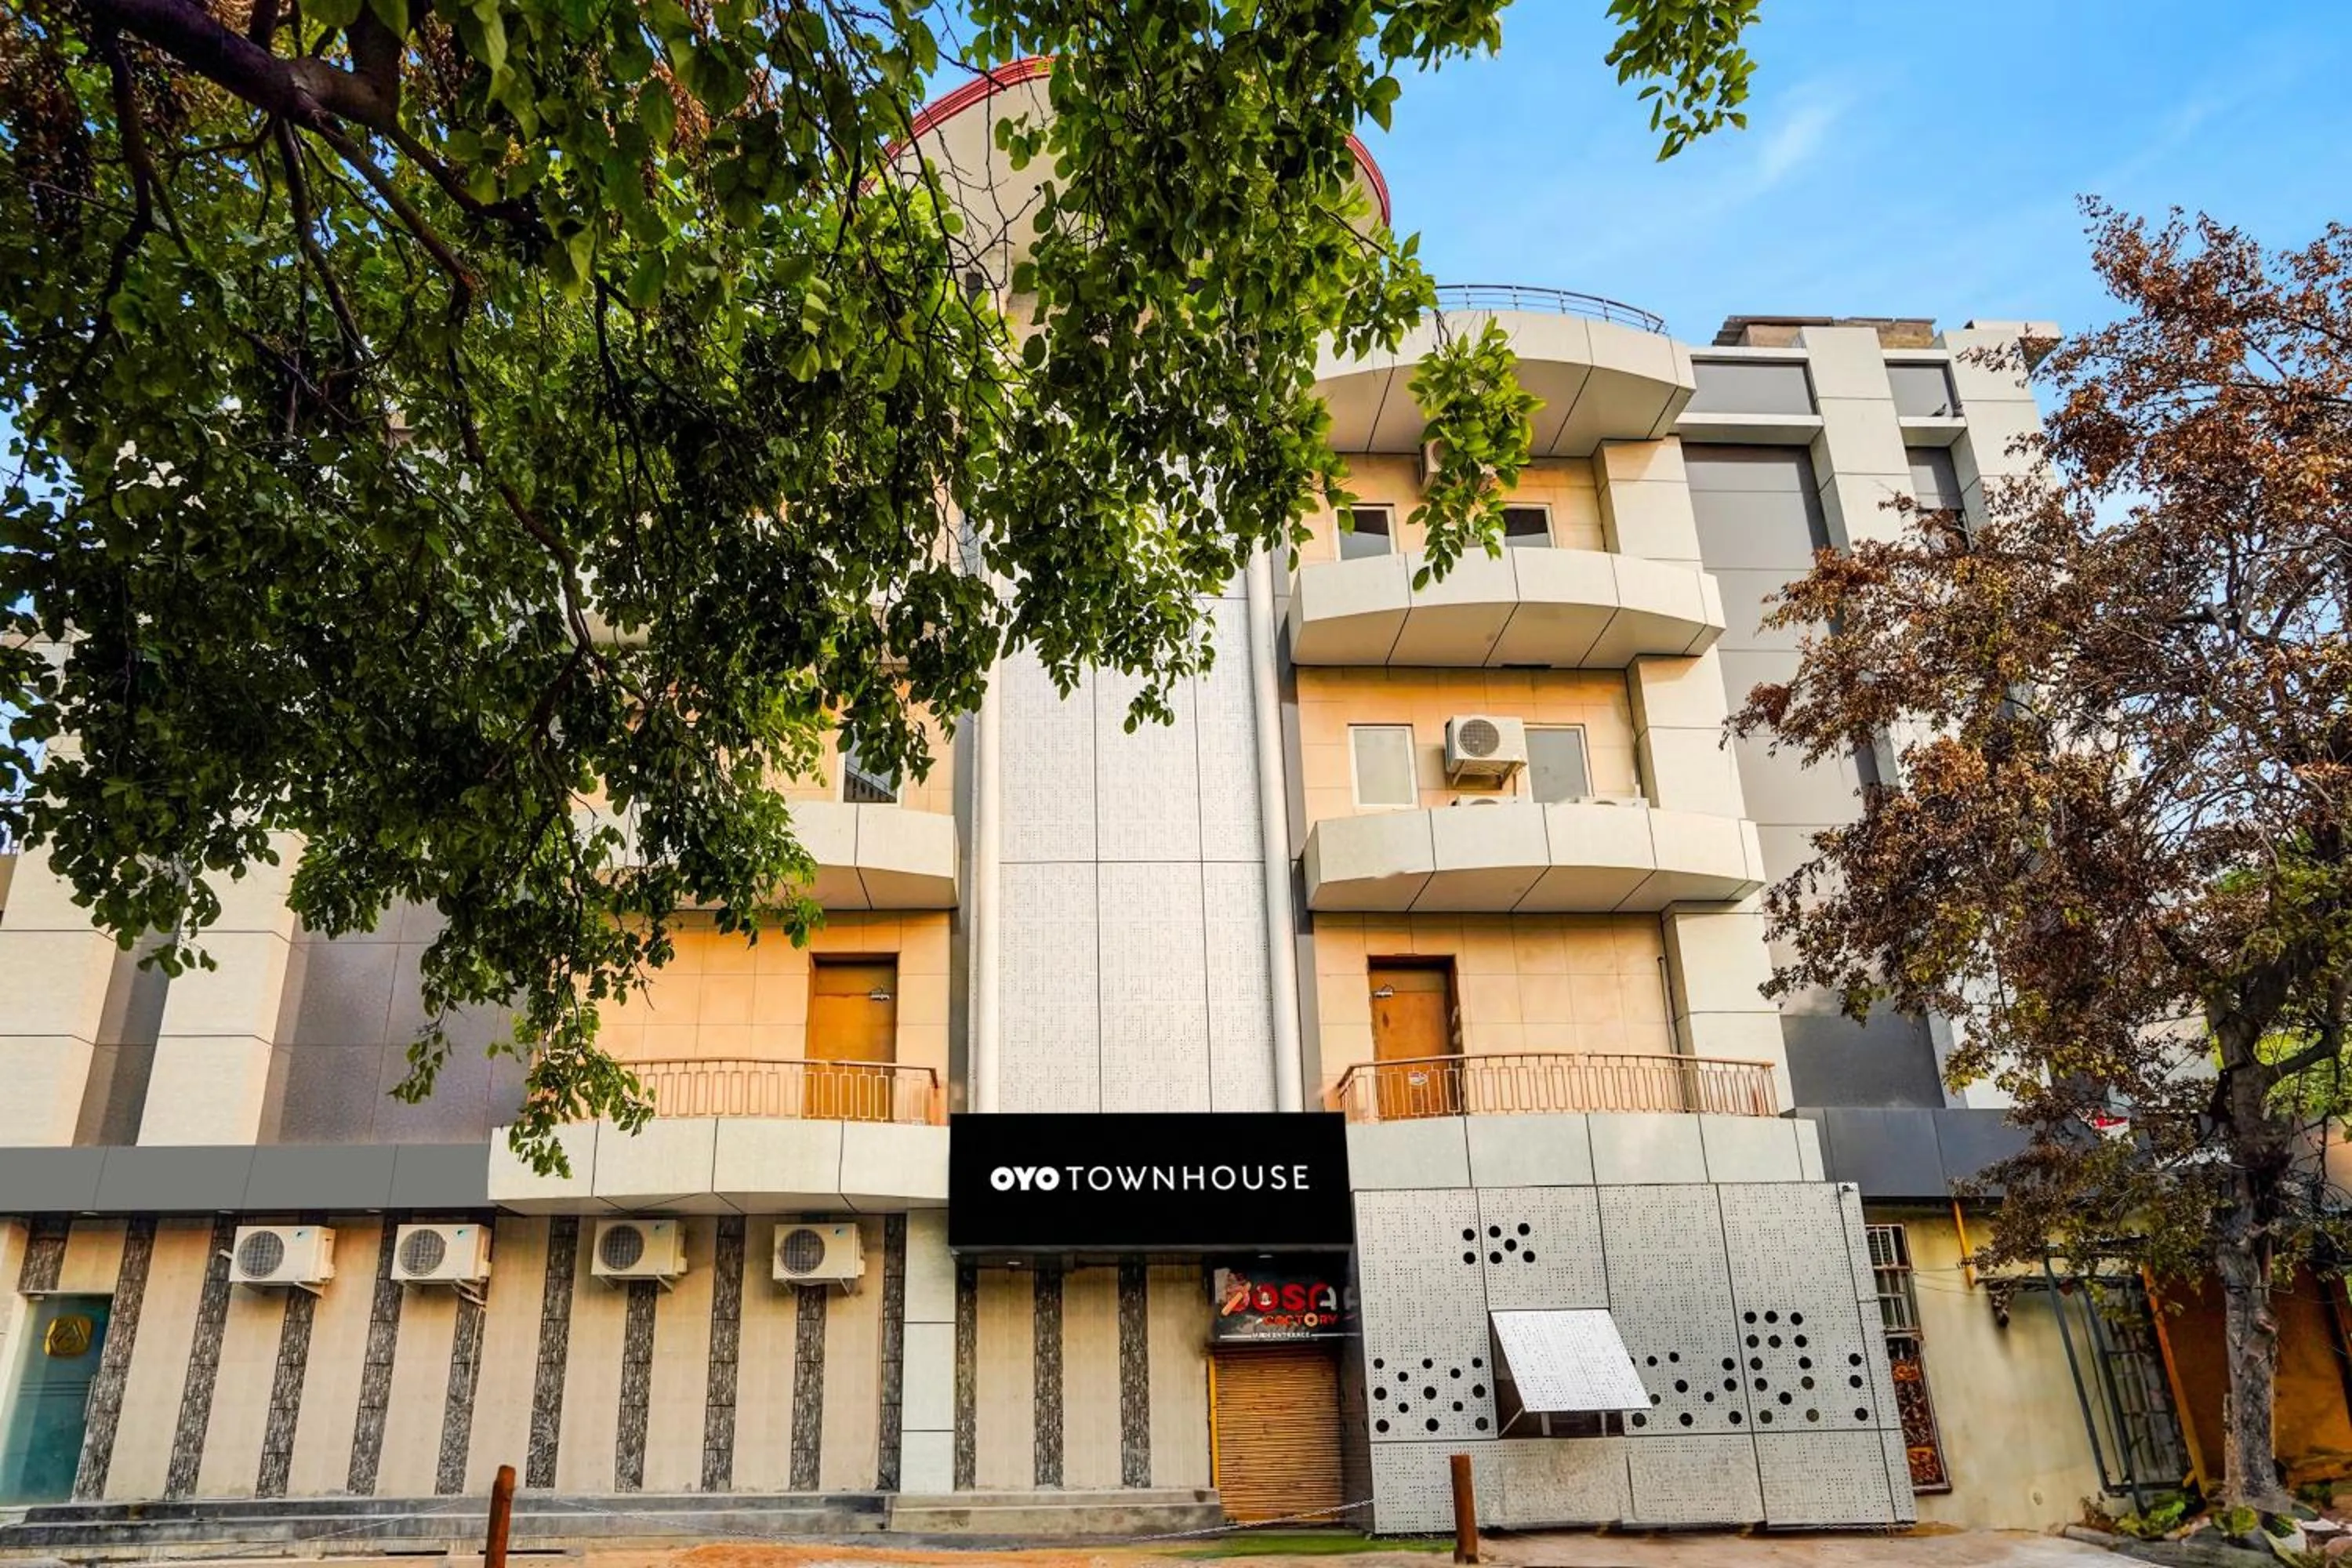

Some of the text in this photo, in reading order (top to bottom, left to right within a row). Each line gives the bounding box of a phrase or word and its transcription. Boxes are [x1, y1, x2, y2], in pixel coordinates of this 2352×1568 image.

[990, 1164, 1310, 1191] OYO TOWNHOUSE
[1221, 1282, 1337, 1316] DOSA
